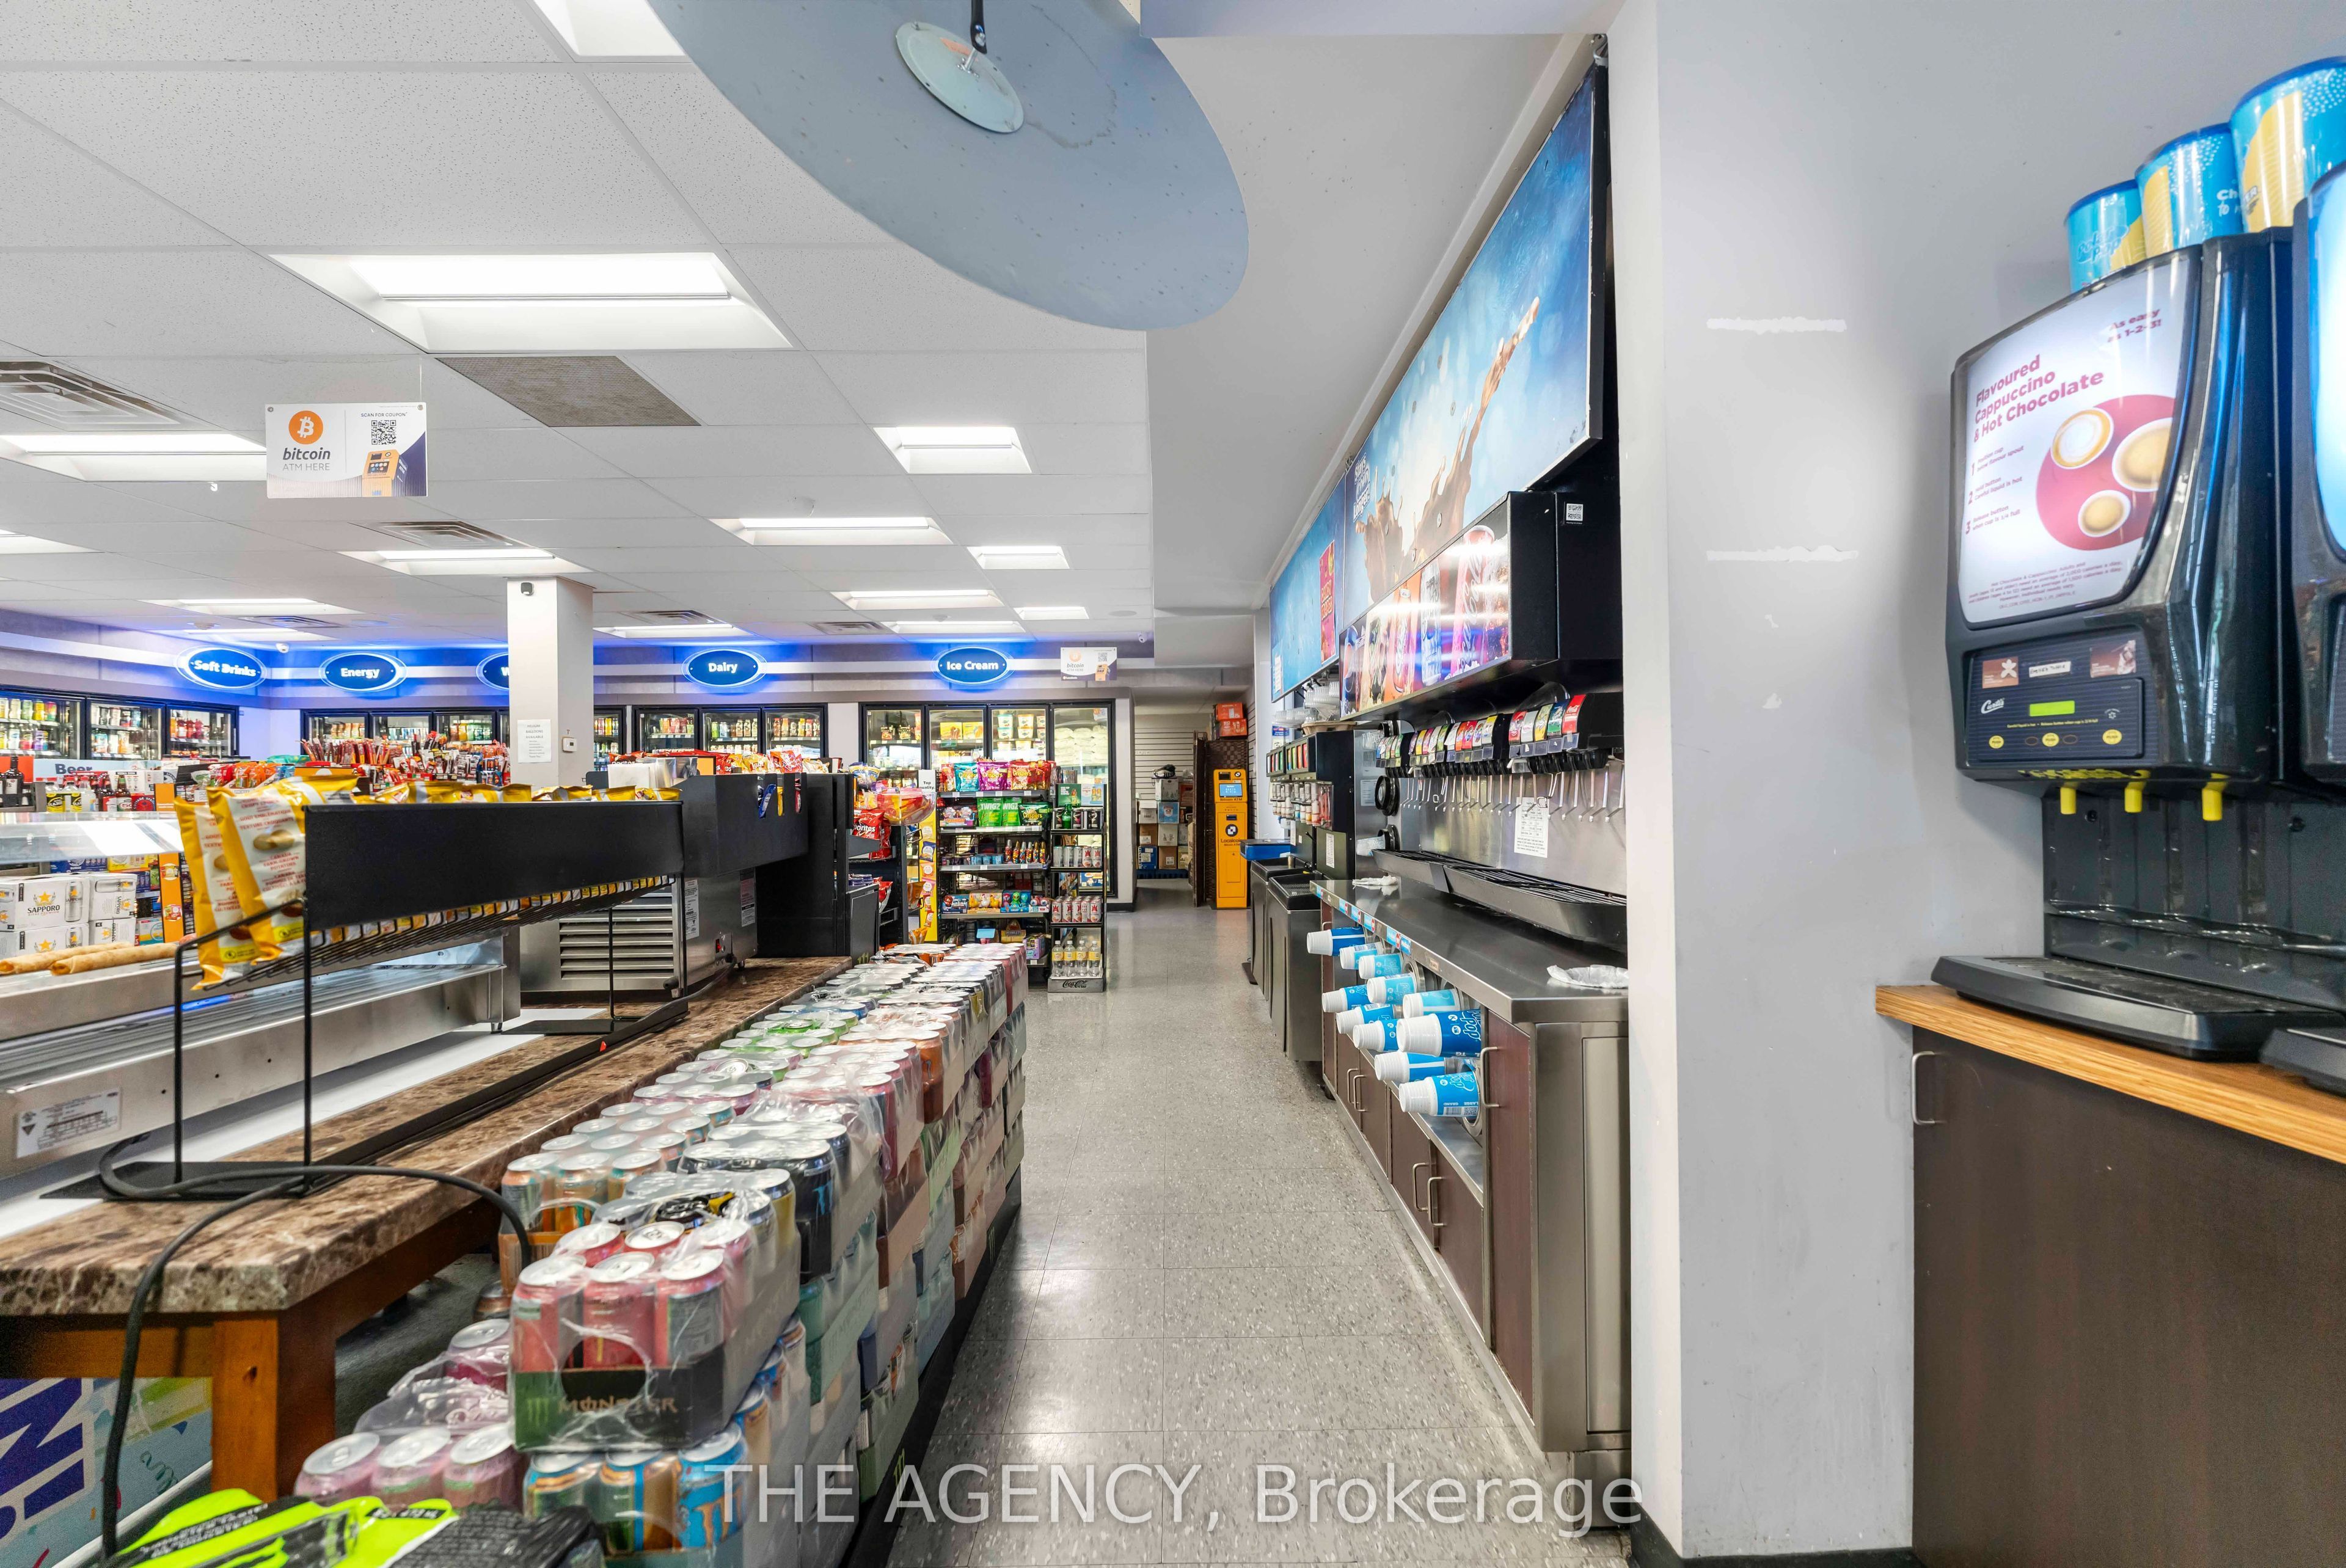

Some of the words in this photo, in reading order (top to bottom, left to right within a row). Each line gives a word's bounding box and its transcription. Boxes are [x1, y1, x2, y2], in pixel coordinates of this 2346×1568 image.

[2110, 321, 2125, 330] As
[2129, 309, 2160, 324] easy
[2125, 319, 2161, 337] 1-2-3!
[1976, 354, 2040, 407] Flavoured
[1975, 371, 2055, 424] Cappuccino
[1973, 429, 1979, 443] &
[1982, 415, 2002, 437] Hot
[2007, 372, 2104, 421] Chocolate
[282, 448, 331, 461] bitcoin
[2008, 446, 2023, 456] spout
[1985, 478, 2001, 487] button
[1968, 491, 1973, 505] 2
[1990, 506, 2009, 515] button
[1965, 520, 1970, 534] 3
[194, 660, 220, 673] Soft
[221, 663, 257, 677] Drinks
[708, 662, 737, 674] Dairy
[947, 661, 962, 671] Ice
[964, 660, 999, 671] Cream
[340, 667, 380, 679] Energy
[55, 764, 93, 775] Beer
[27, 905, 60, 914] SAPPORO
